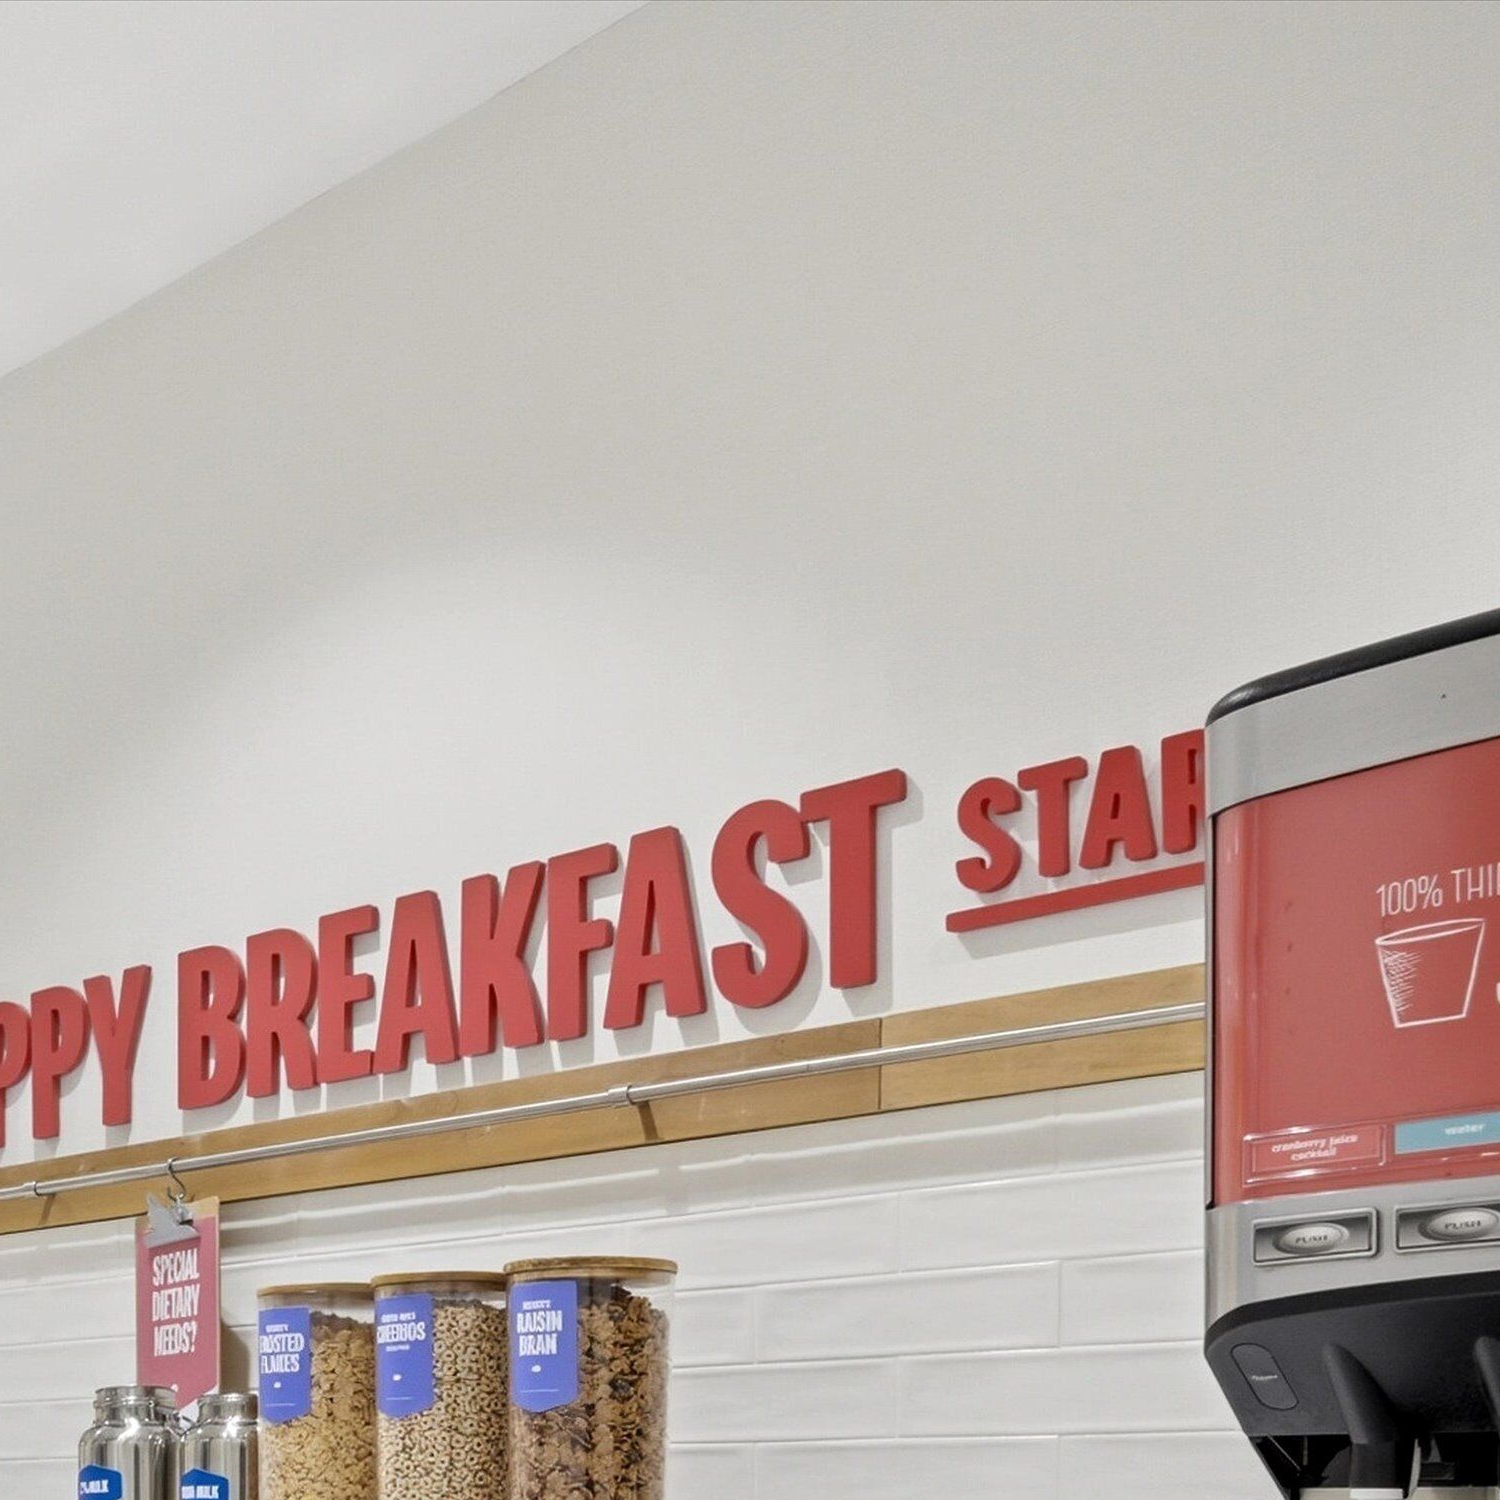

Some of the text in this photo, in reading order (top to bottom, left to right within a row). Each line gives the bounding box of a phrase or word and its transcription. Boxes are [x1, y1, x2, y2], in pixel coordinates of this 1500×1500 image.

[1376, 862, 1500, 917] 100% THI
[177, 768, 908, 1110] BREAKFAST
[152, 1248, 200, 1287] SPECIAL
[151, 1283, 201, 1322] DIETARY
[153, 1320, 198, 1357] NEEDS?
[516, 1310, 563, 1334] RAISIN
[518, 1333, 558, 1357] BRAN
[196, 1485, 220, 1500] MILK
